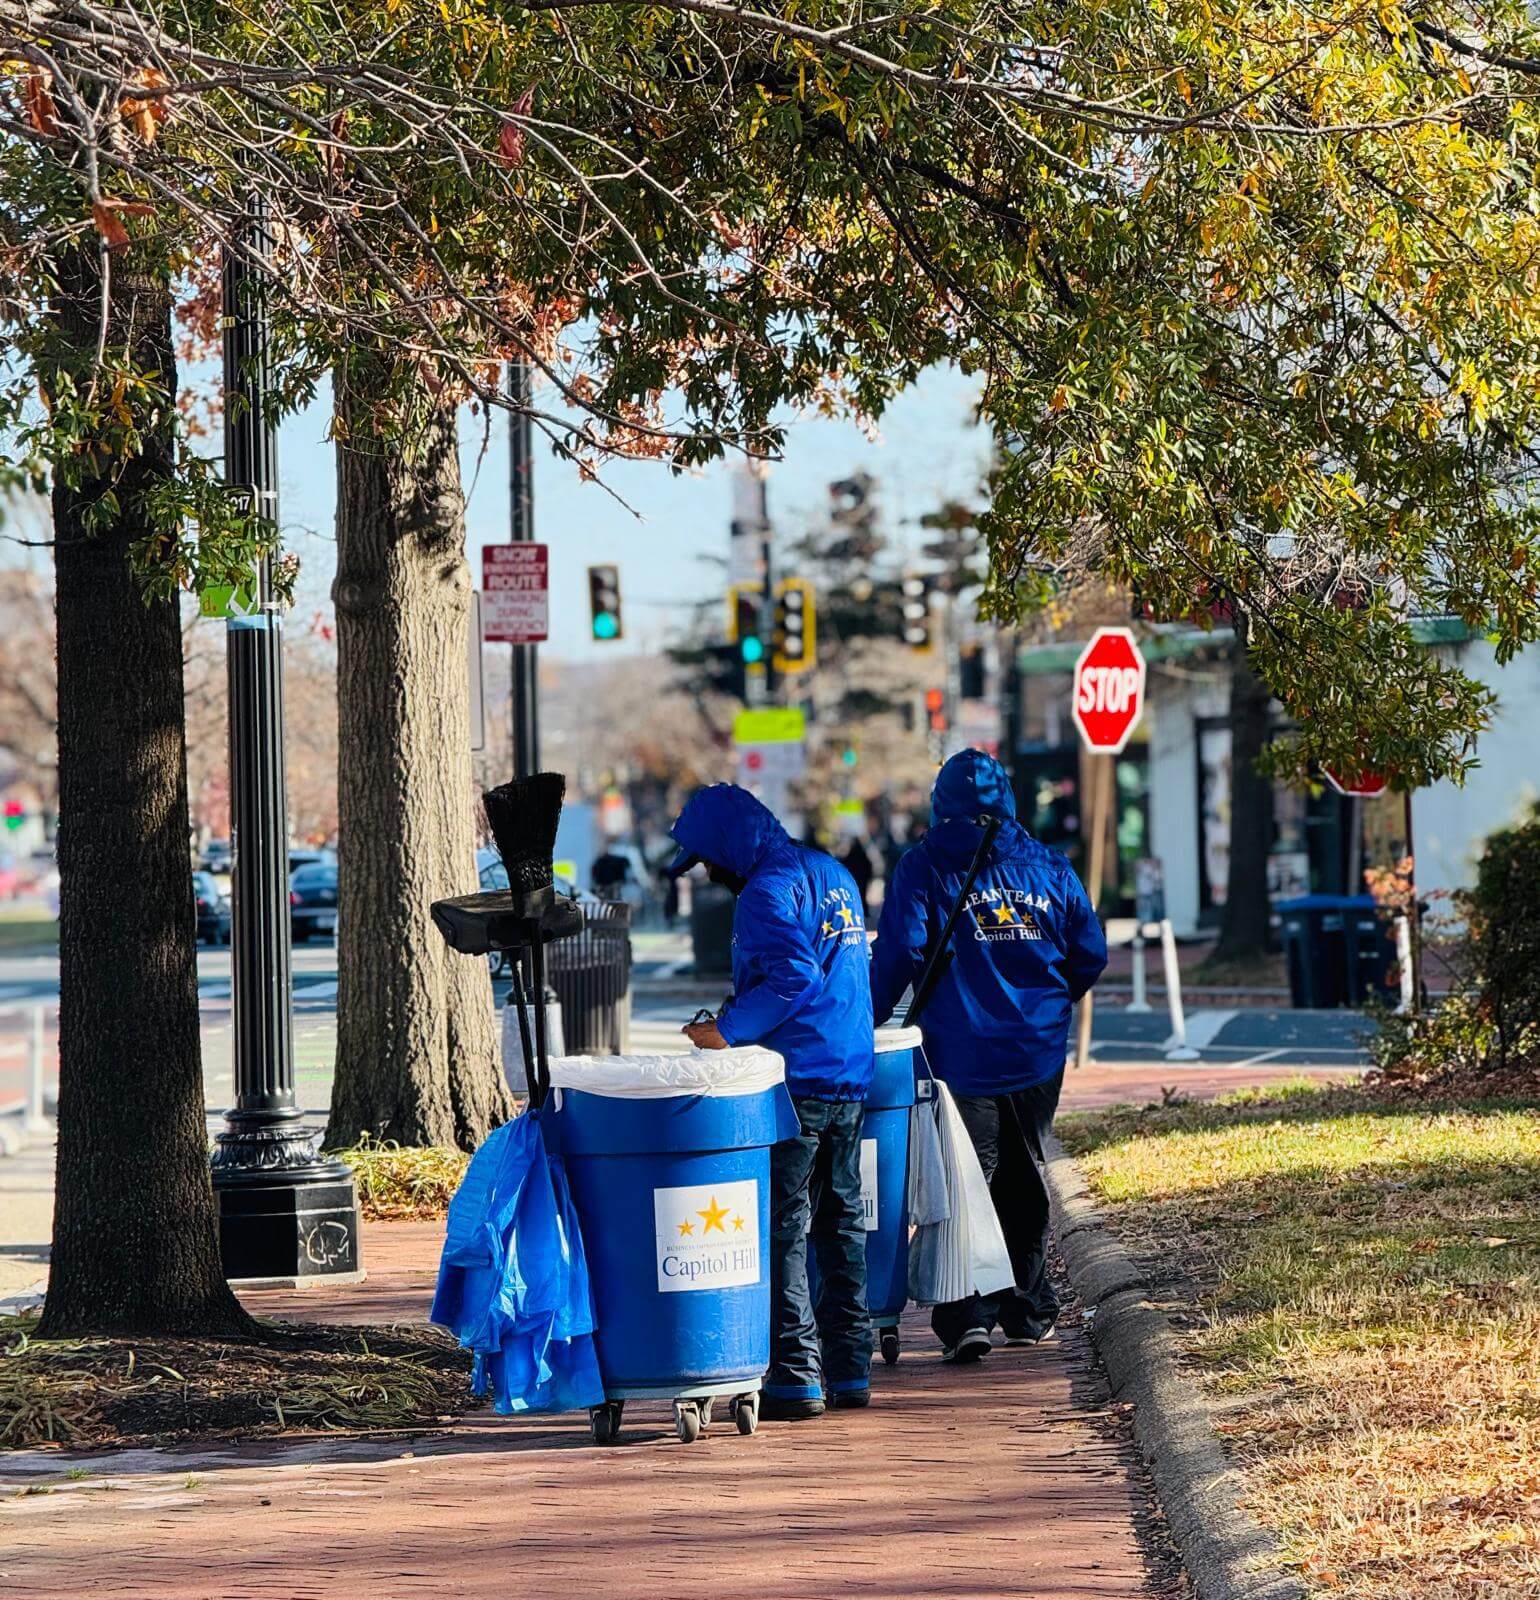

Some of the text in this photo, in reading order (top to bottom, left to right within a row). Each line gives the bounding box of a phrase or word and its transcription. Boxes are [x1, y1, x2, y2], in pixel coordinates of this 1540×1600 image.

[492, 547, 537, 562] SNOW
[488, 574, 541, 590] ROUTE
[496, 606, 534, 618] DURING
[1079, 666, 1138, 714] STOP
[961, 887, 1051, 913] LEAN TEAM
[1018, 927, 1042, 941] Hill
[662, 1247, 757, 1281] Capitol Hill
